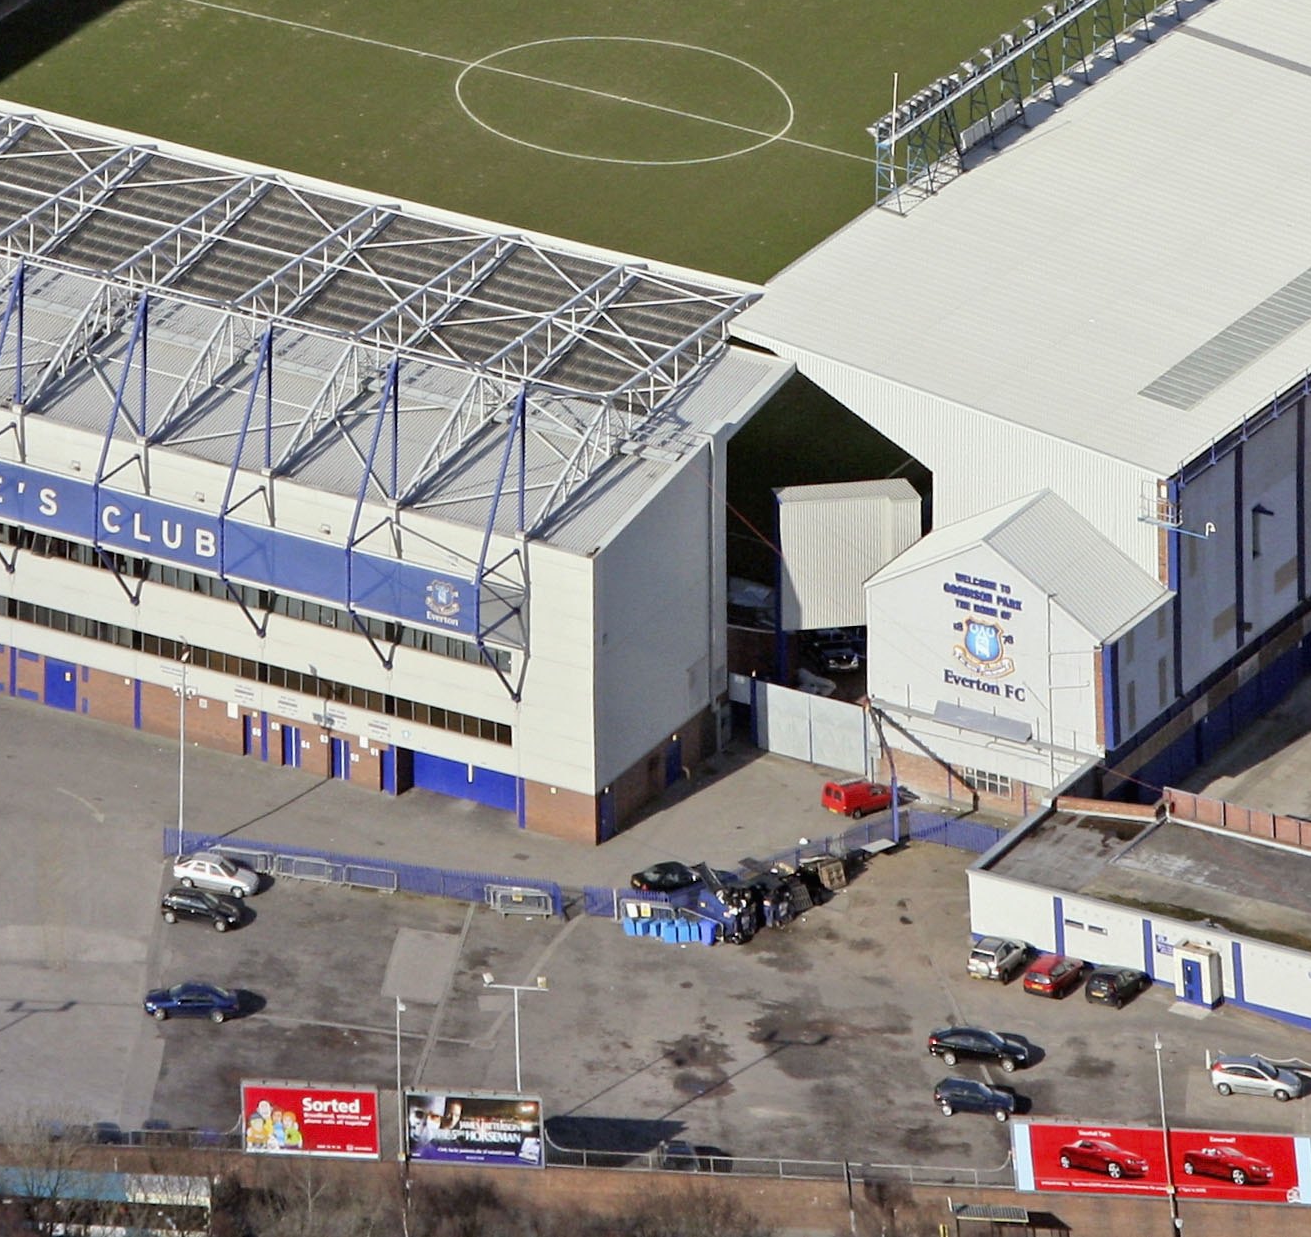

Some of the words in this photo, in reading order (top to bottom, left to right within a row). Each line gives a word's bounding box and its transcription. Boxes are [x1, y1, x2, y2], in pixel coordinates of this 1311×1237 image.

[102, 505, 217, 557] CLUB
[426, 610, 459, 627] Everton
[943, 668, 1000, 696] Everton
[1004, 683, 1026, 702] FC
[301, 1096, 360, 1113] Sorted
[465, 1131, 521, 1143] HORSEMAN
